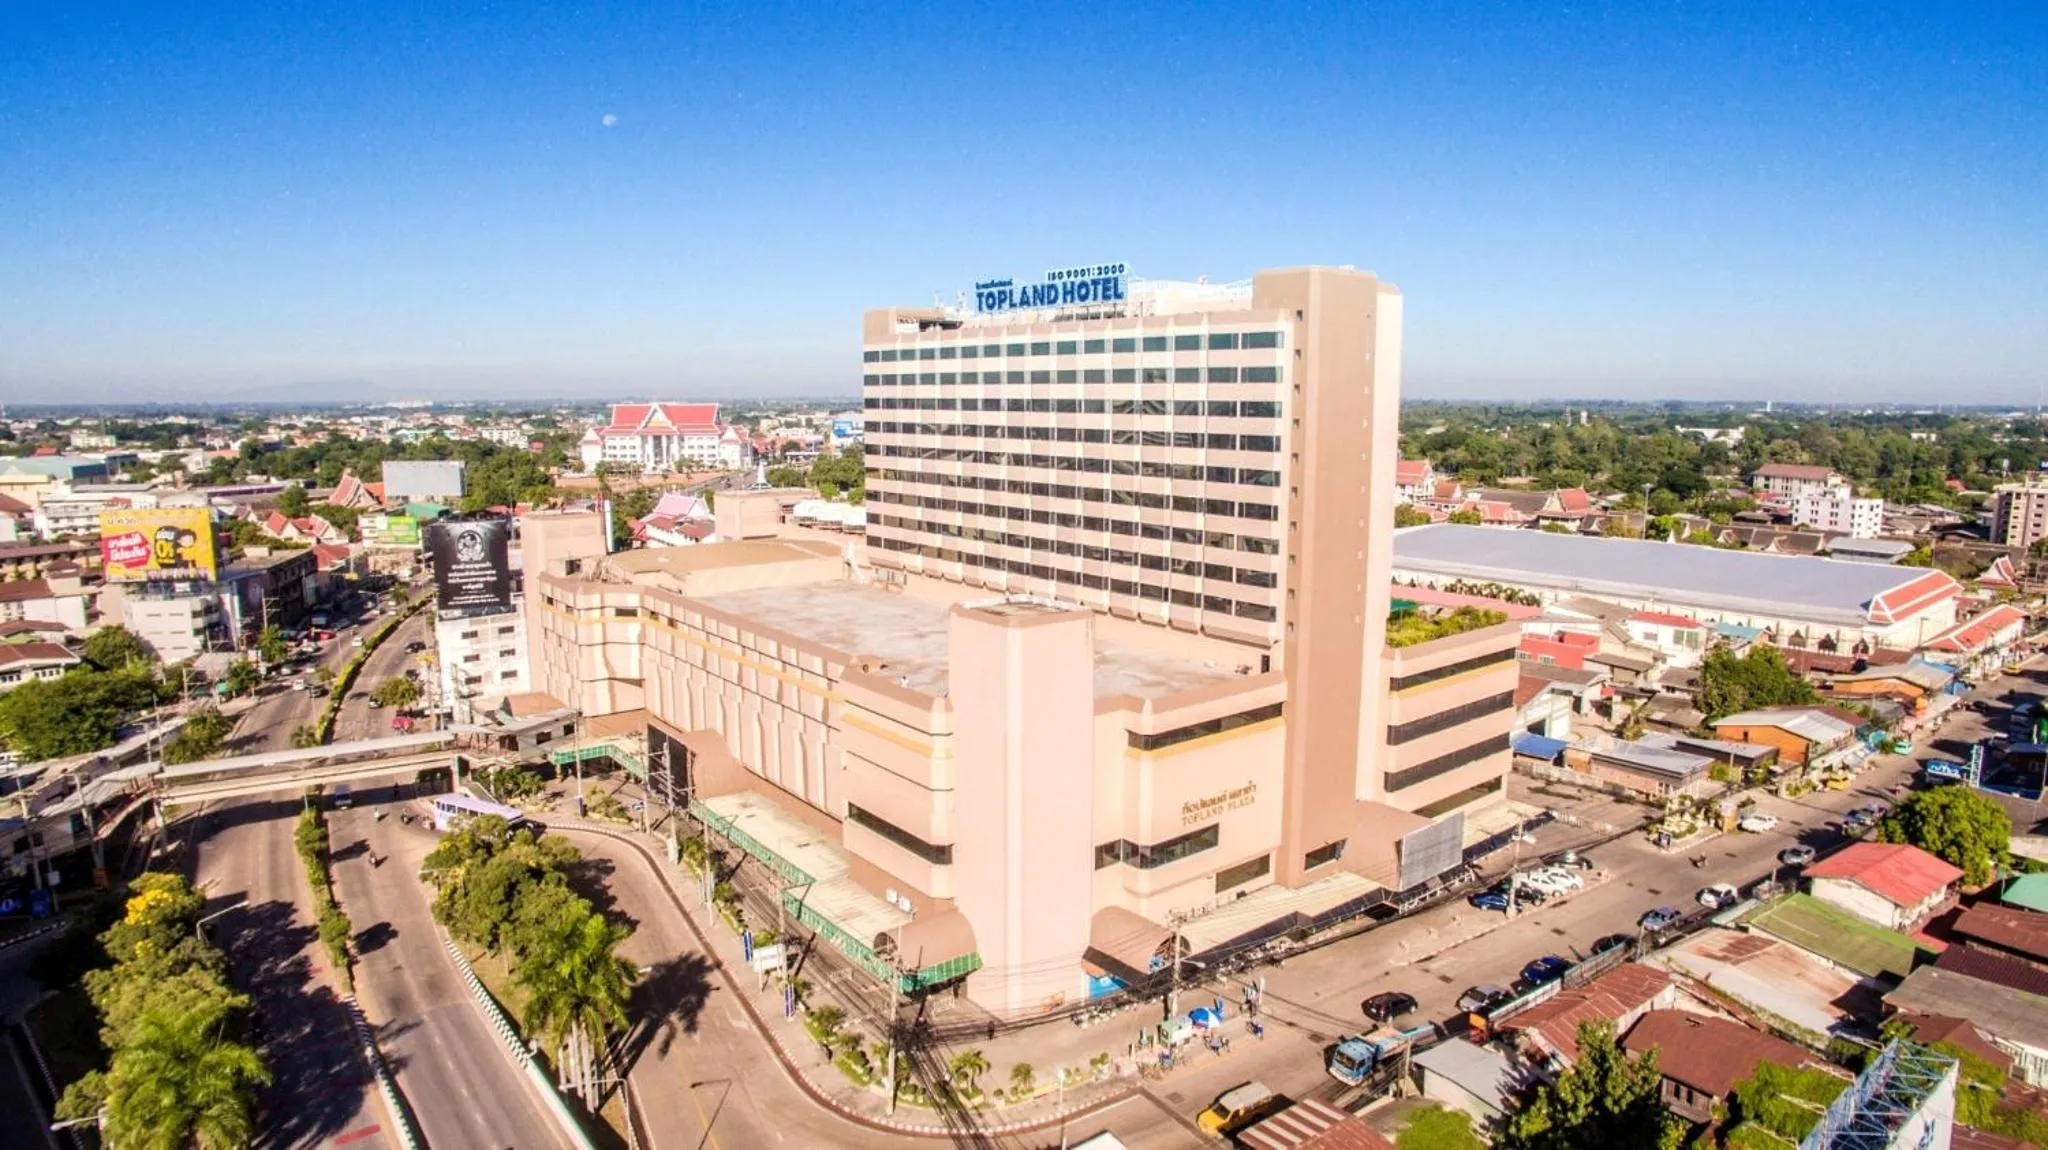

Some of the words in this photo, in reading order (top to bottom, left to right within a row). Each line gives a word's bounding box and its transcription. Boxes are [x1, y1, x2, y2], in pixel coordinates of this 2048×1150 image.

[1047, 270, 1064, 281] ISO
[976, 283, 1059, 312] TOPLAND
[1062, 276, 1124, 304] HOTEL
